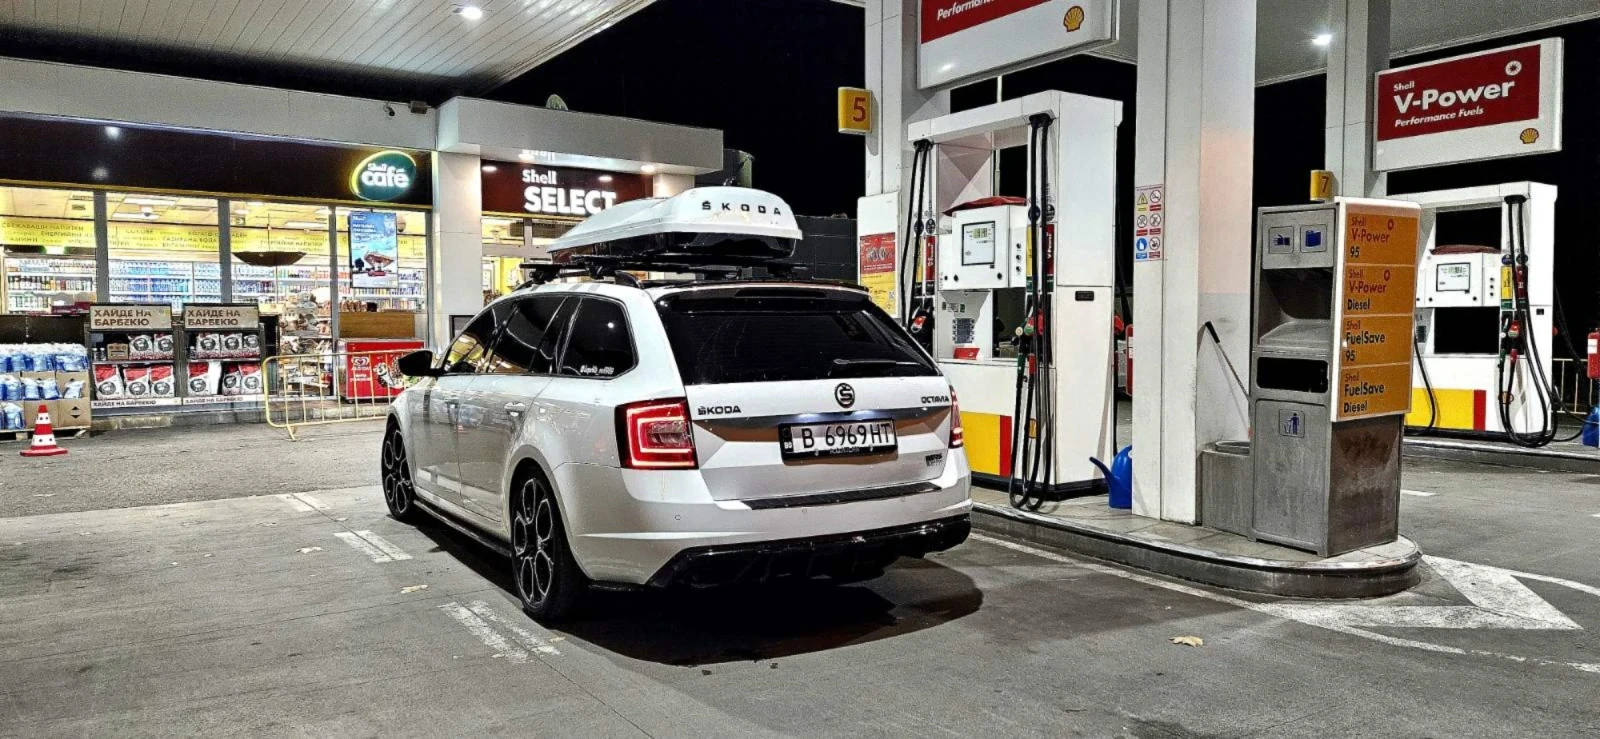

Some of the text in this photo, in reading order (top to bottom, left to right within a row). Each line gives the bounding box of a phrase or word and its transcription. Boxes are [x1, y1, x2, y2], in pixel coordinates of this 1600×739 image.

[937, 0, 994, 20] Performa
[1393, 81, 1415, 92] Shell
[1393, 81, 1515, 114] V-Power
[852, 96, 866, 122] 5
[1394, 106, 1484, 127] Performance Fuels
[361, 165, 410, 188] café
[522, 168, 557, 185] Shell
[1321, 175, 1329, 193] 7
[523, 186, 617, 215] SELECT
[1351, 216, 1366, 227] Shell
[1351, 229, 1390, 242] V-Power
[1350, 246, 1360, 258] 95
[1348, 269, 1363, 279] Shell
[1348, 281, 1387, 294] V-Power
[1347, 299, 1370, 310] Diesel
[94, 308, 152, 318] ХАЙДЕ НА
[187, 308, 240, 318] ХАЙДЕ НА
[94, 318, 150, 326] БАРБЕКЮ
[187, 318, 239, 326] БАРБЕКЮ
[1345, 331, 1385, 345] FuelSave
[1345, 350, 1355, 361] 95
[1344, 381, 1385, 397] FuelSave
[921, 396, 950, 404] OCTAVIA
[1343, 400, 1367, 413] Diesel
[801, 428, 815, 449] B
[825, 424, 867, 447] 6969
